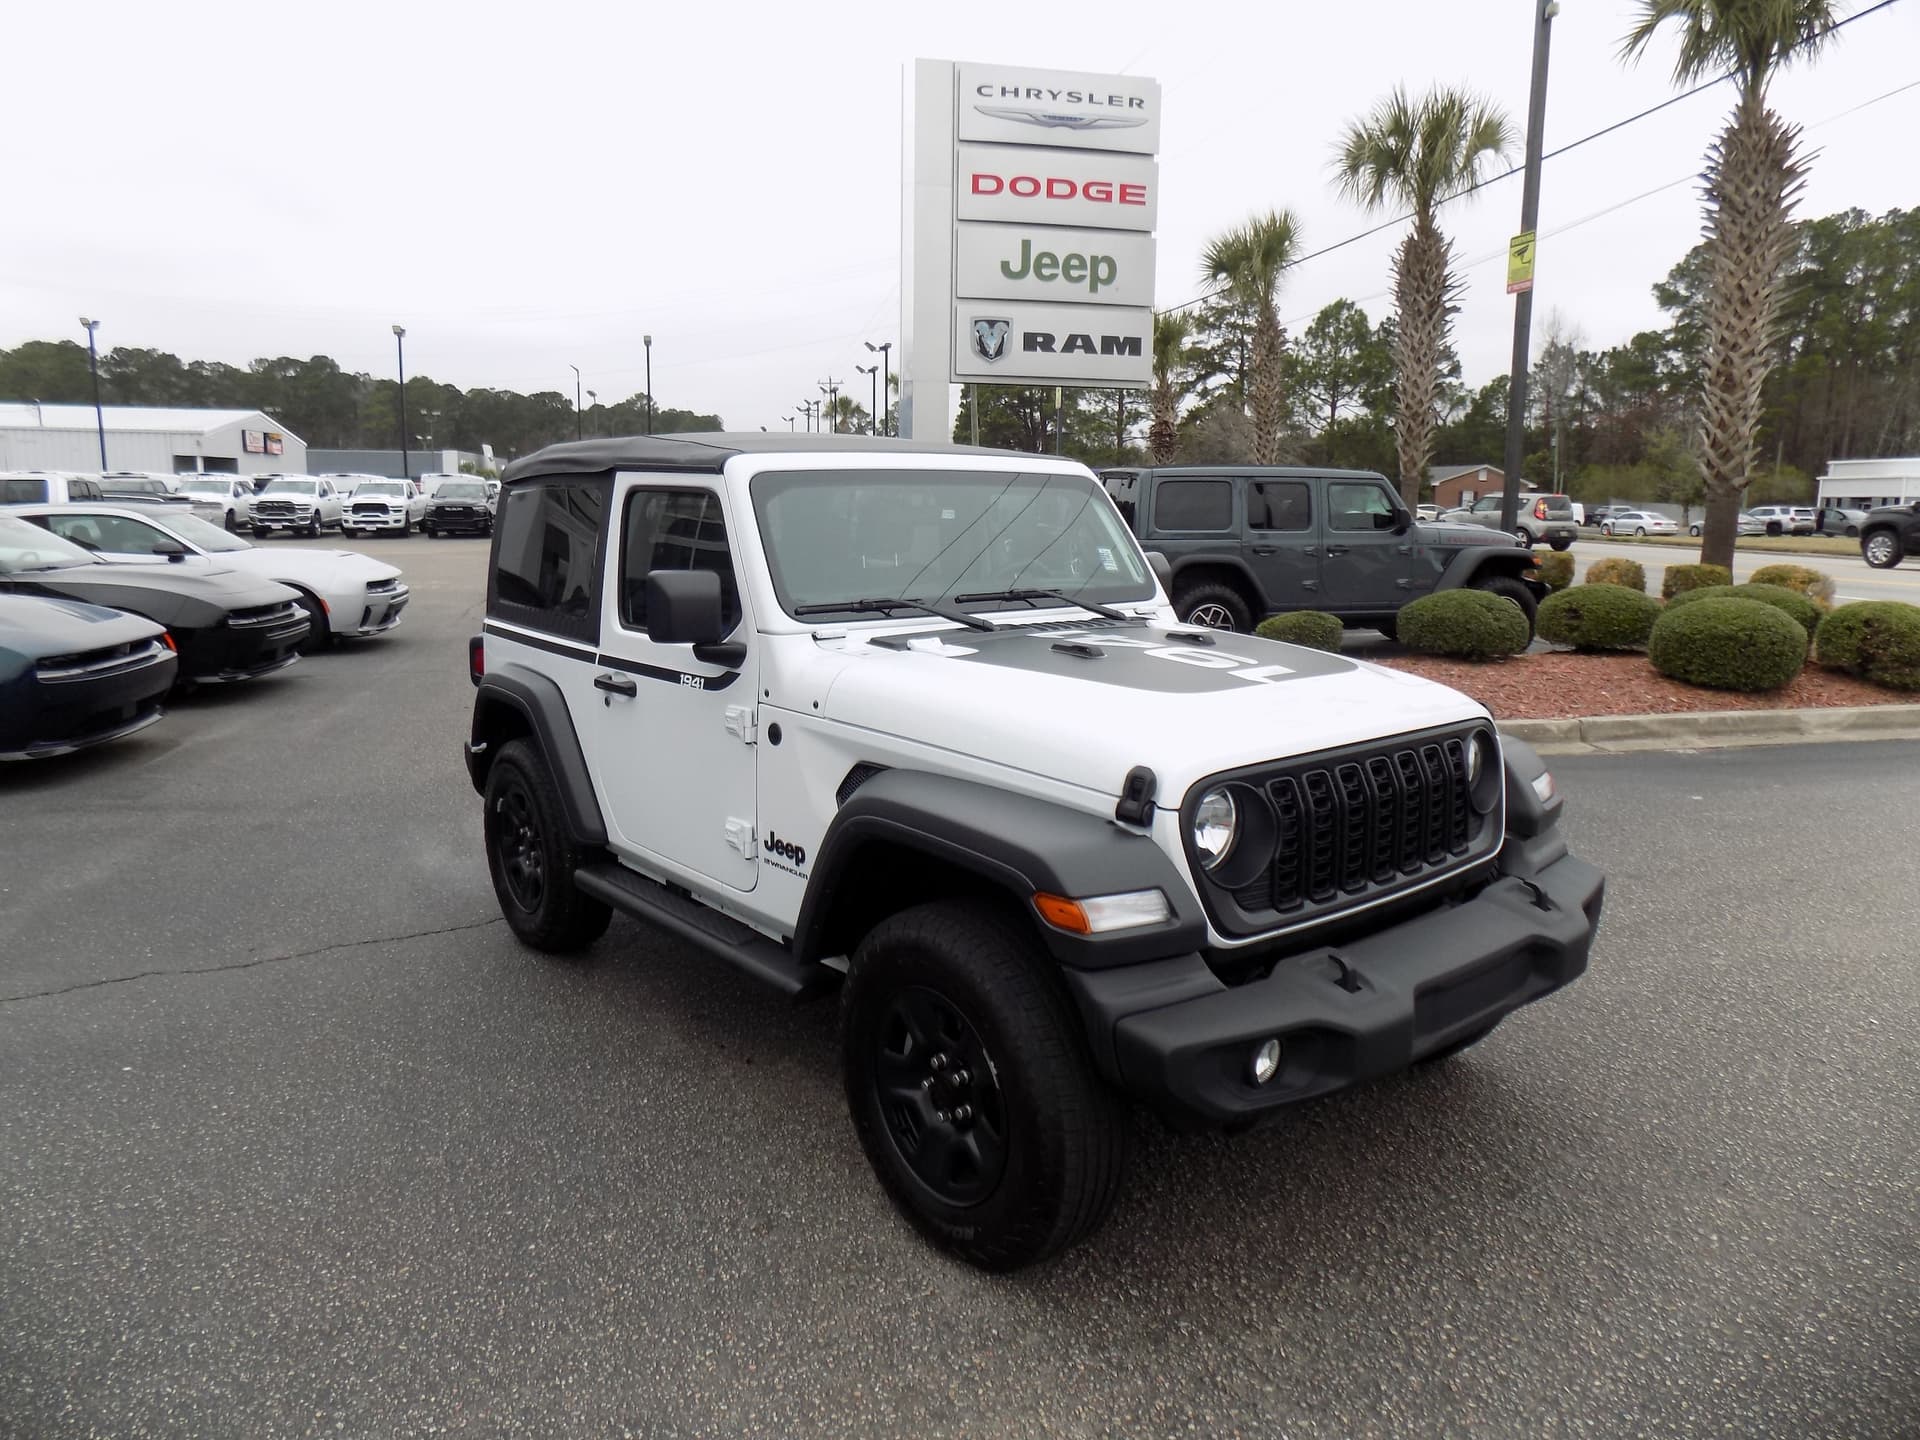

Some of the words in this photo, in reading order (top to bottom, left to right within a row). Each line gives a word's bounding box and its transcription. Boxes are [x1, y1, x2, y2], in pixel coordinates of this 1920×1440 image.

[976, 84, 1145, 110] CHRYSLER
[971, 173, 1147, 206] DODGE
[1000, 239, 1118, 293] Jeep
[1022, 331, 1143, 357] RAM
[680, 673, 705, 690] 1941
[763, 830, 806, 867] Jeep
